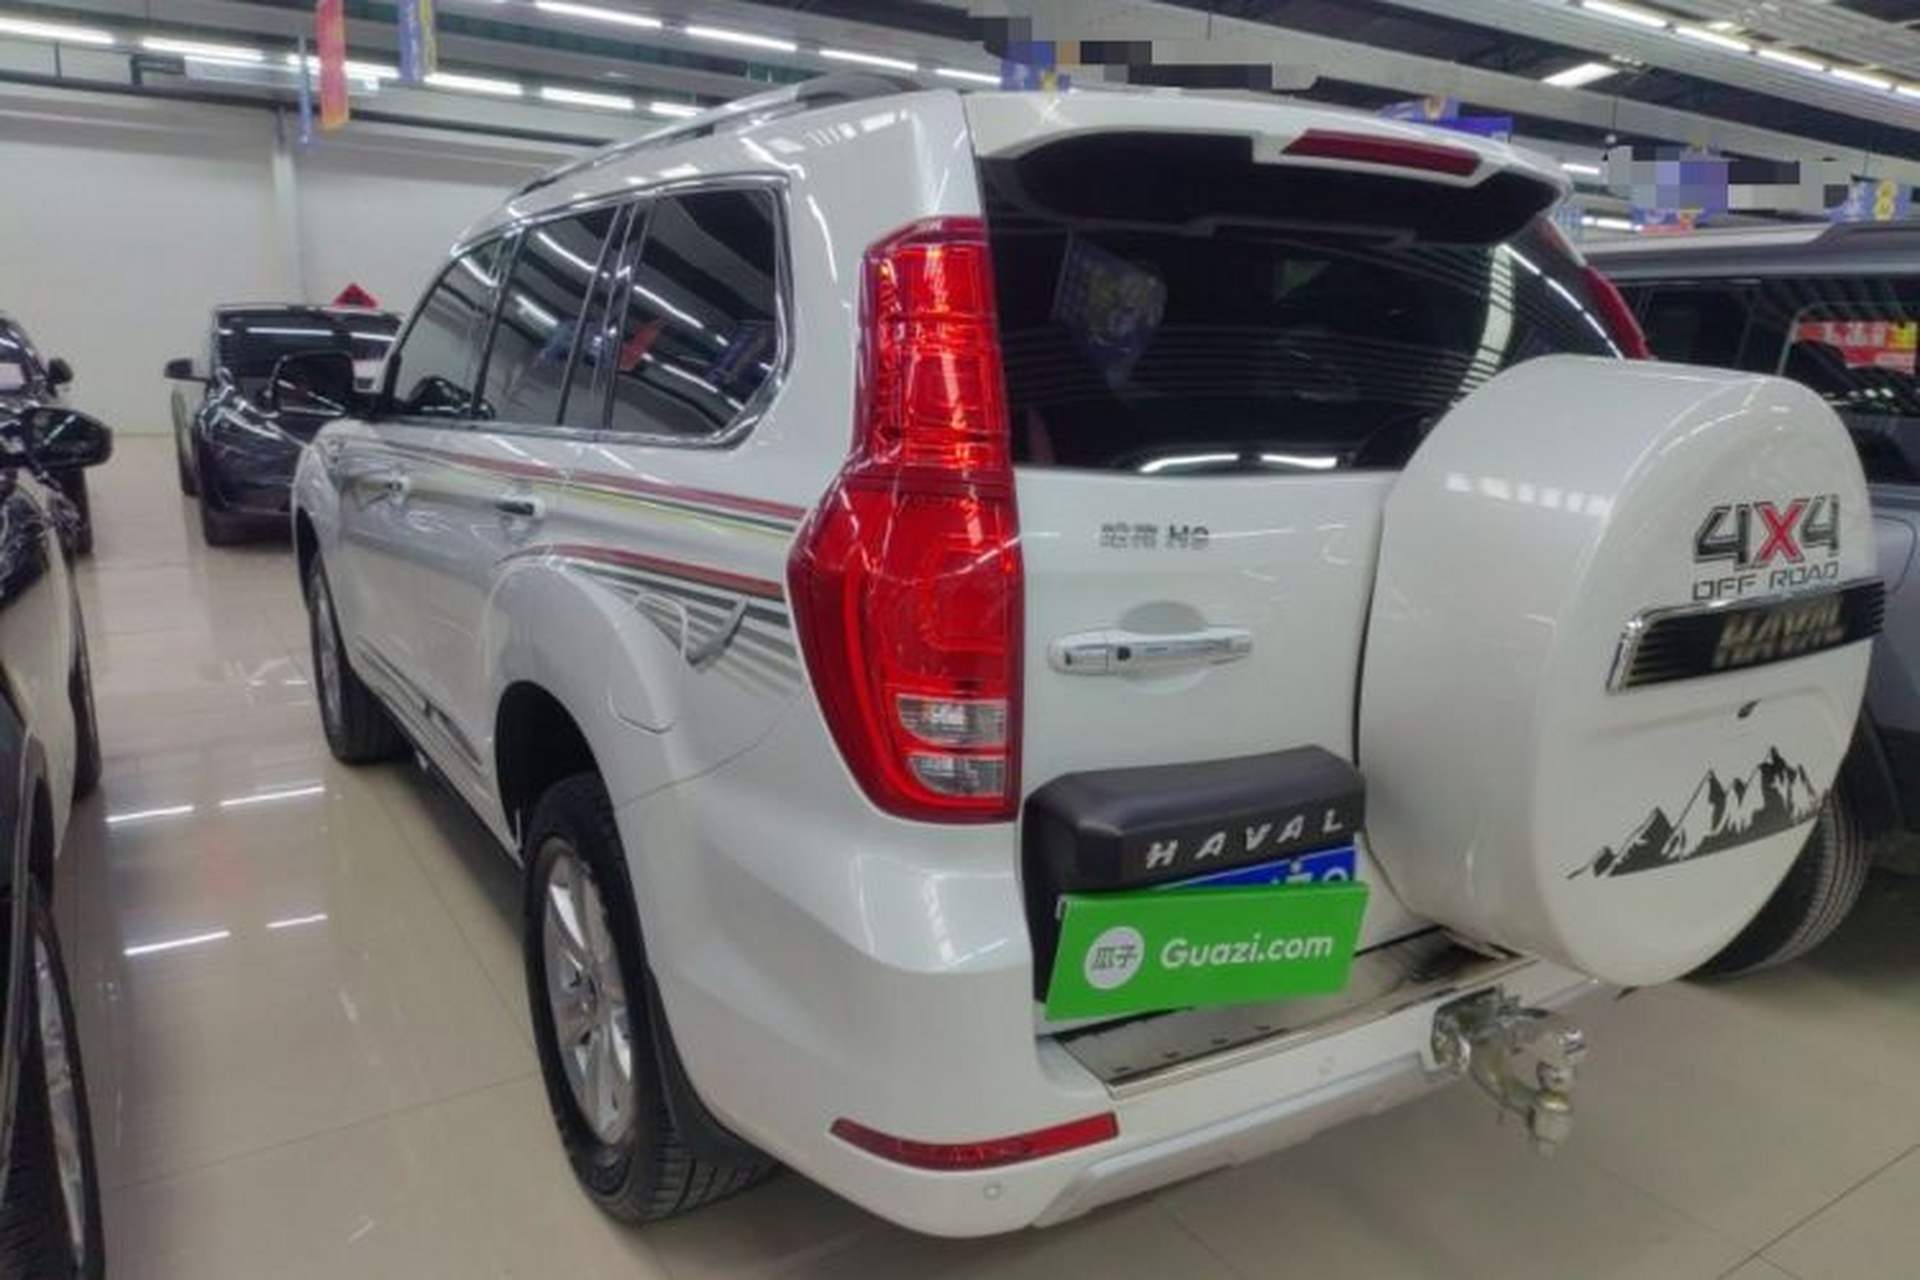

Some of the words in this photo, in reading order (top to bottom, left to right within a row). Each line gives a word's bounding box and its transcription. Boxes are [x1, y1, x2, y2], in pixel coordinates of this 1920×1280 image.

[1694, 495, 1840, 571] 4X4
[1693, 573, 1756, 601] OFF
[1769, 561, 1839, 588] ROAD
[1146, 808, 1343, 869] HAVAL
[1160, 932, 1333, 969] Guazi.com
